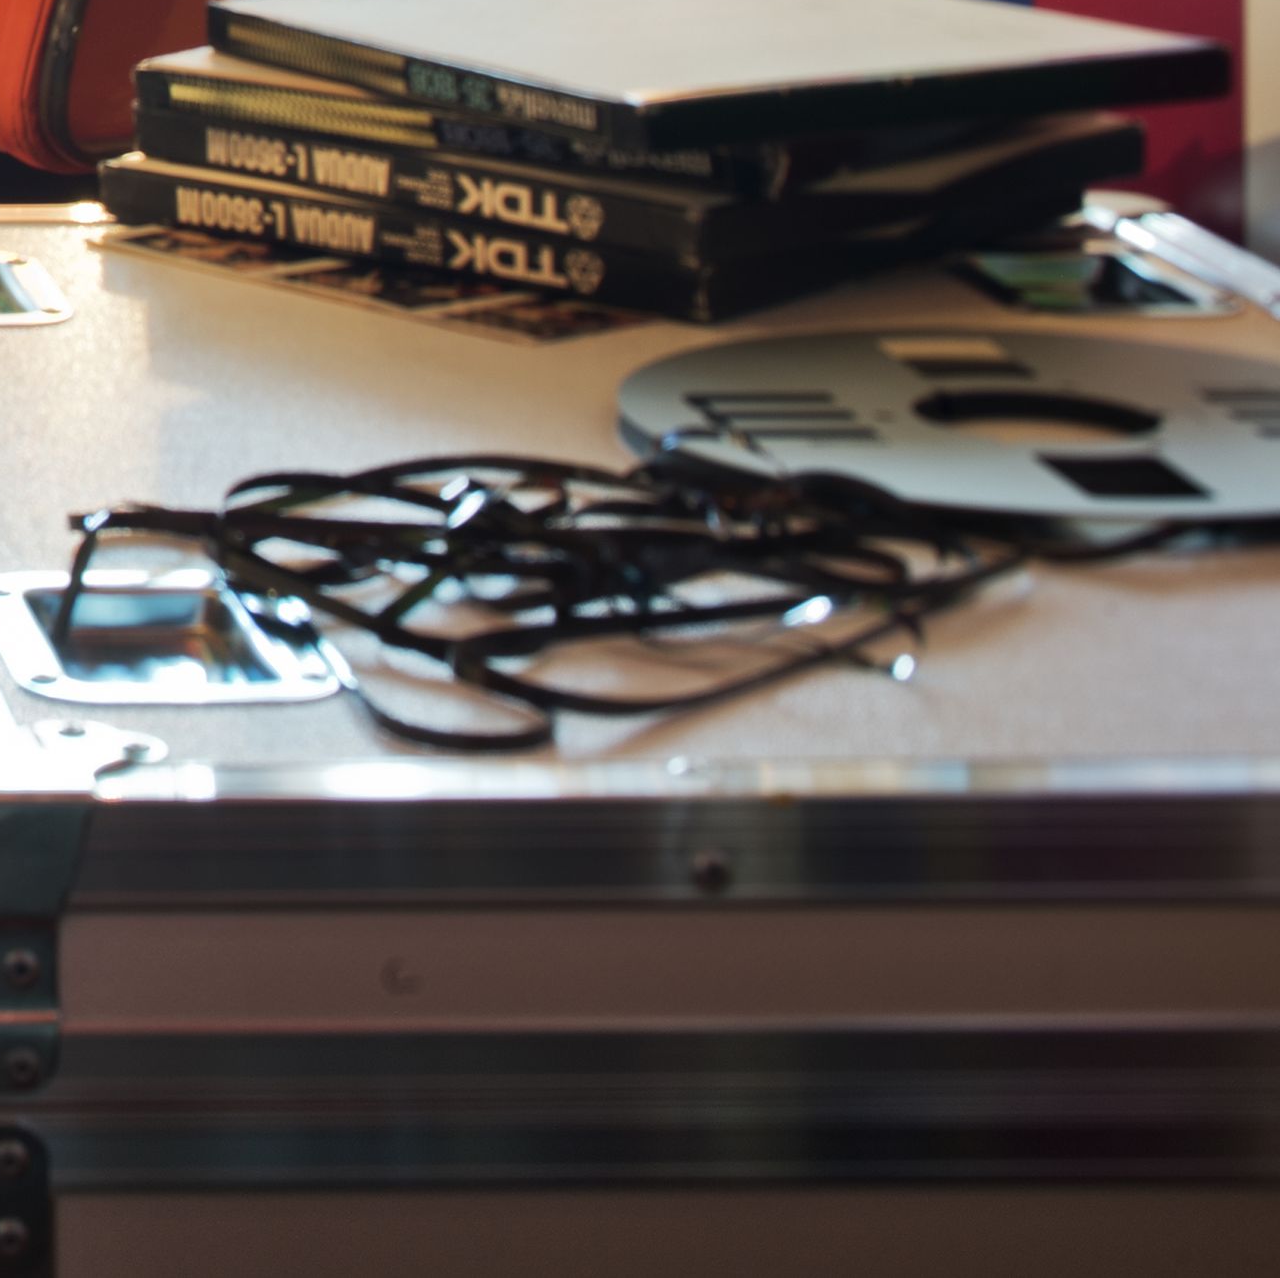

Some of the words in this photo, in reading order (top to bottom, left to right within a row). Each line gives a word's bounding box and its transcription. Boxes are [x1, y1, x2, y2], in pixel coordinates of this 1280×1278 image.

[290, 201, 376, 255] AUDUA
[455, 171, 570, 234] TDK
[447, 227, 569, 289] TDK
